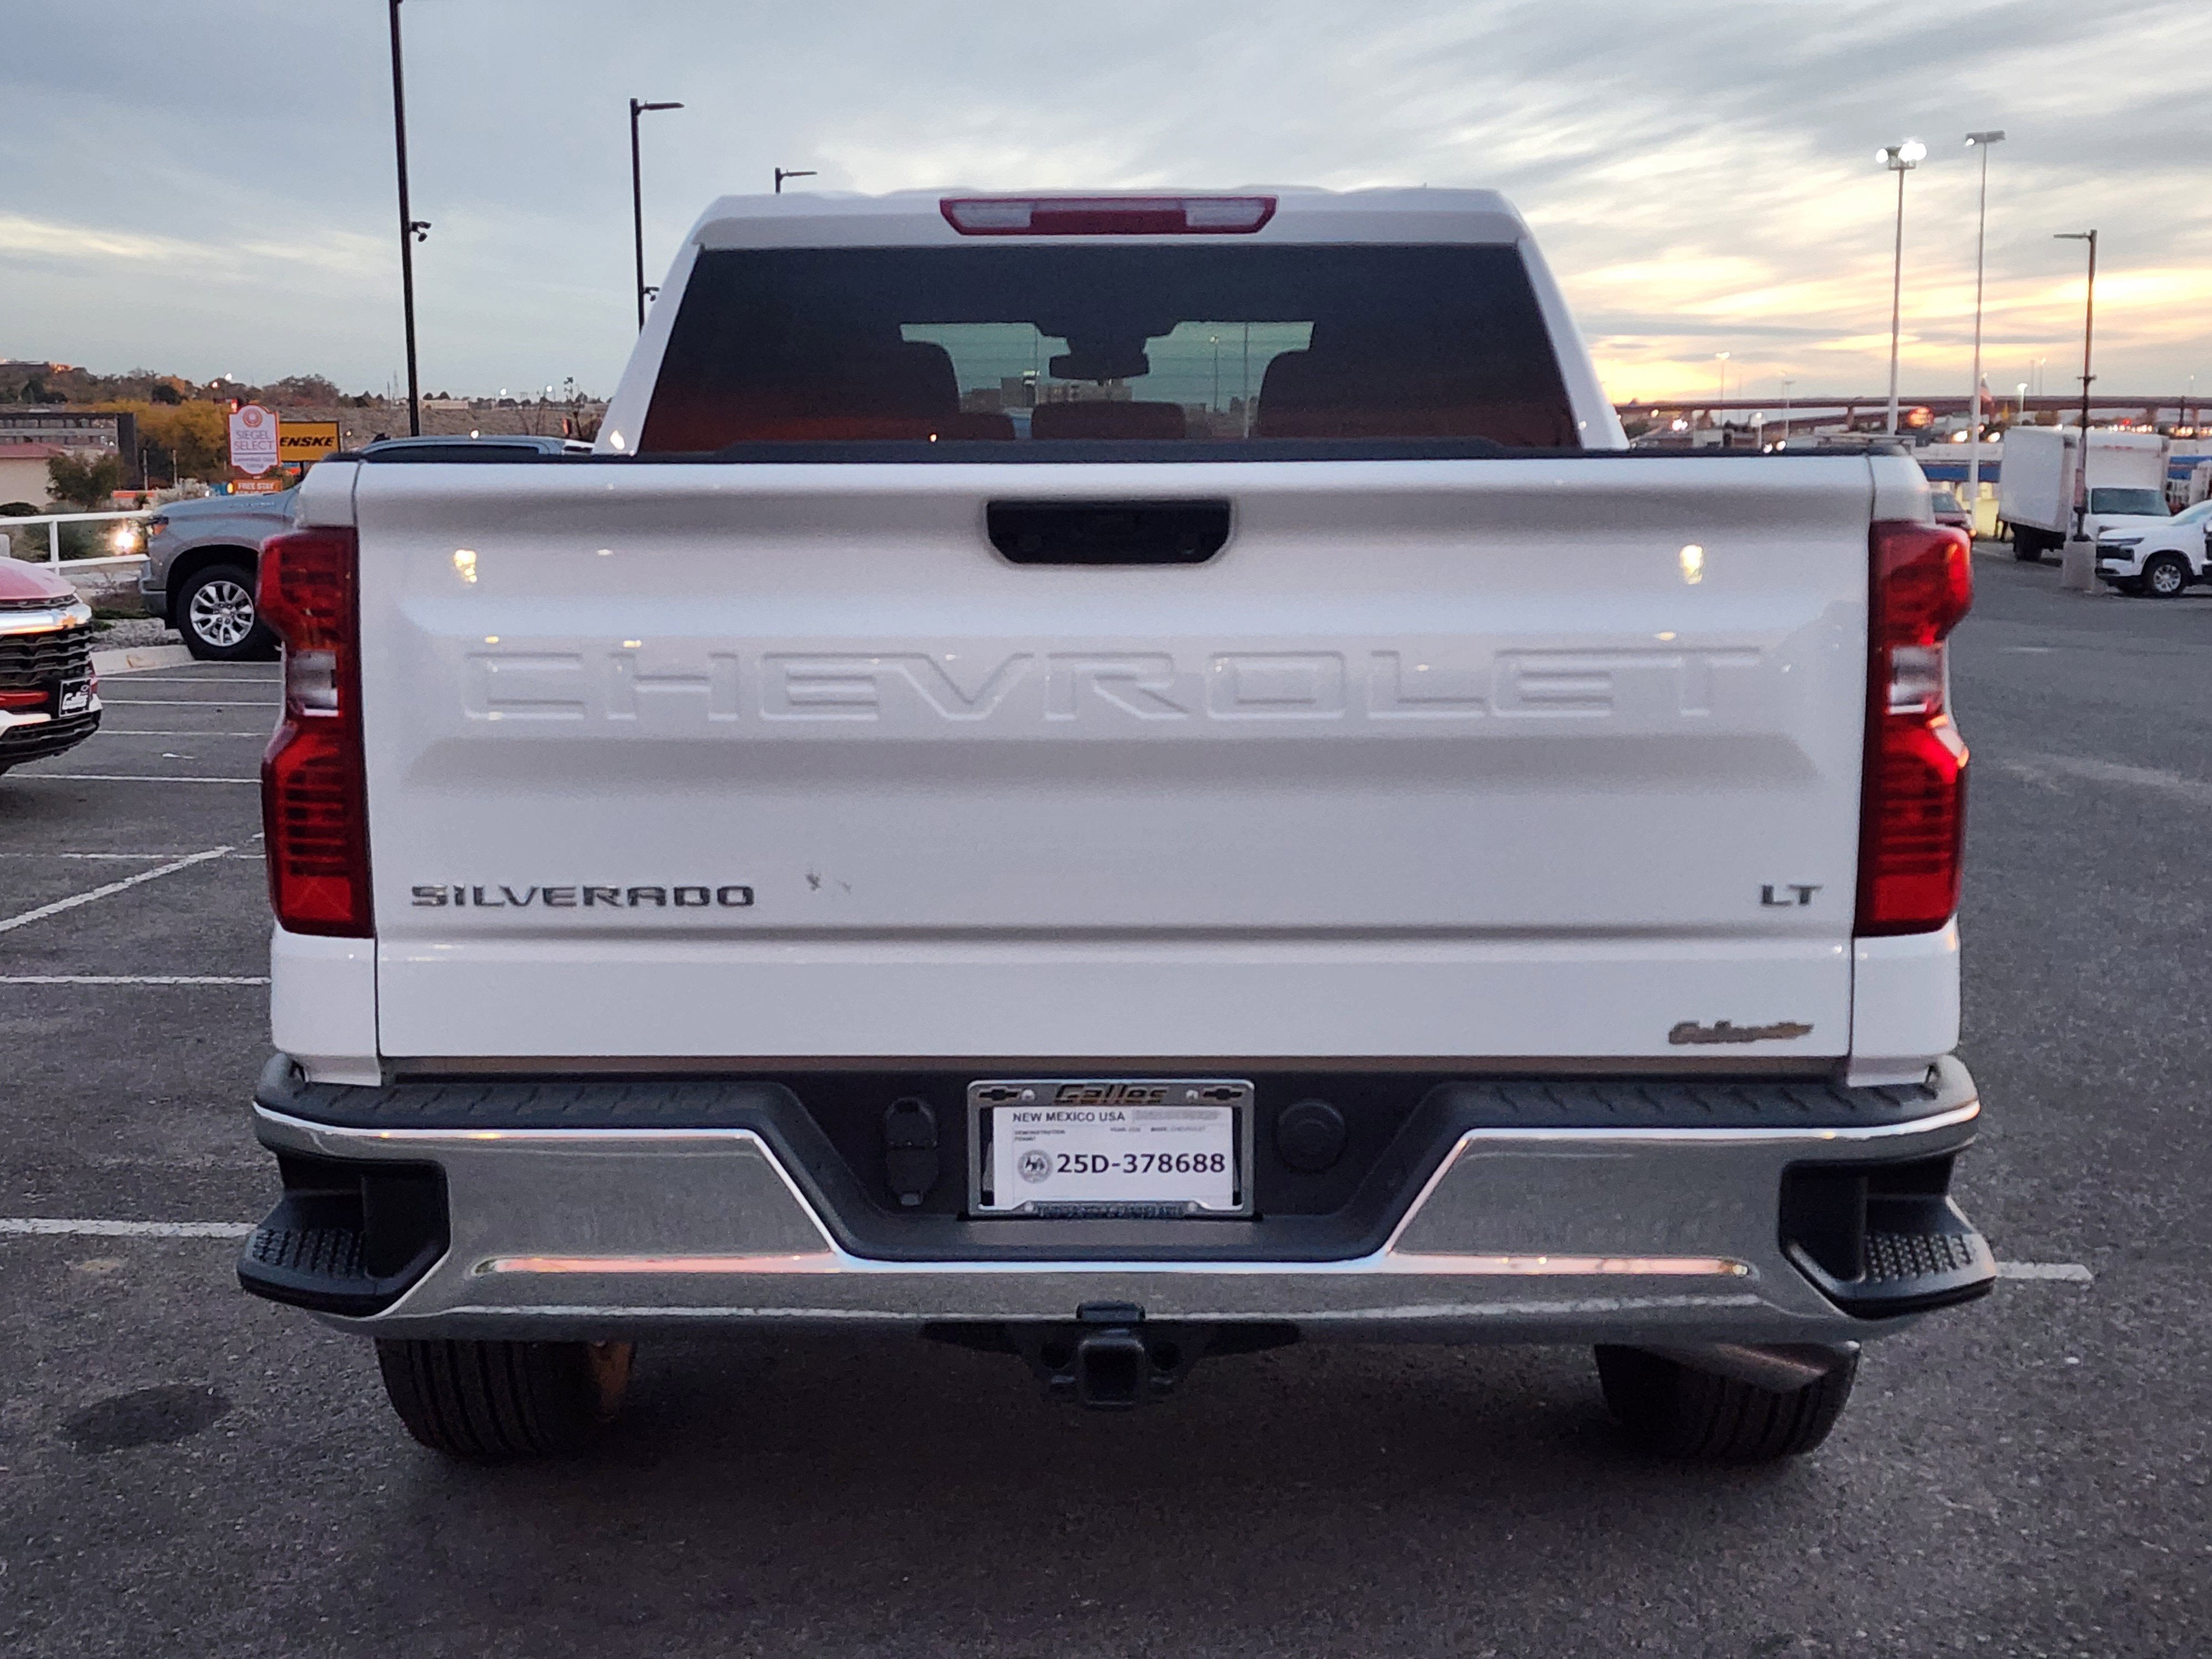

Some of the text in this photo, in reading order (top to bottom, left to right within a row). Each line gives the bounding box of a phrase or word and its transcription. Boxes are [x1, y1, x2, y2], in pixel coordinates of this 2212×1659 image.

[234, 440, 275, 450] SELECT
[236, 430, 271, 440] SIEGEL
[280, 436, 335, 447] ENSKE
[461, 646, 1762, 722] CHEVROLET
[410, 884, 755, 907] SILVERADO
[1761, 884, 1823, 906] LT
[1053, 1084, 1168, 1104] Galles
[1013, 1112, 1042, 1123] NEW
[1045, 1111, 1095, 1123] MEXICO
[1099, 1110, 1126, 1122] USA
[1056, 1152, 1225, 1174] 25D-378688
